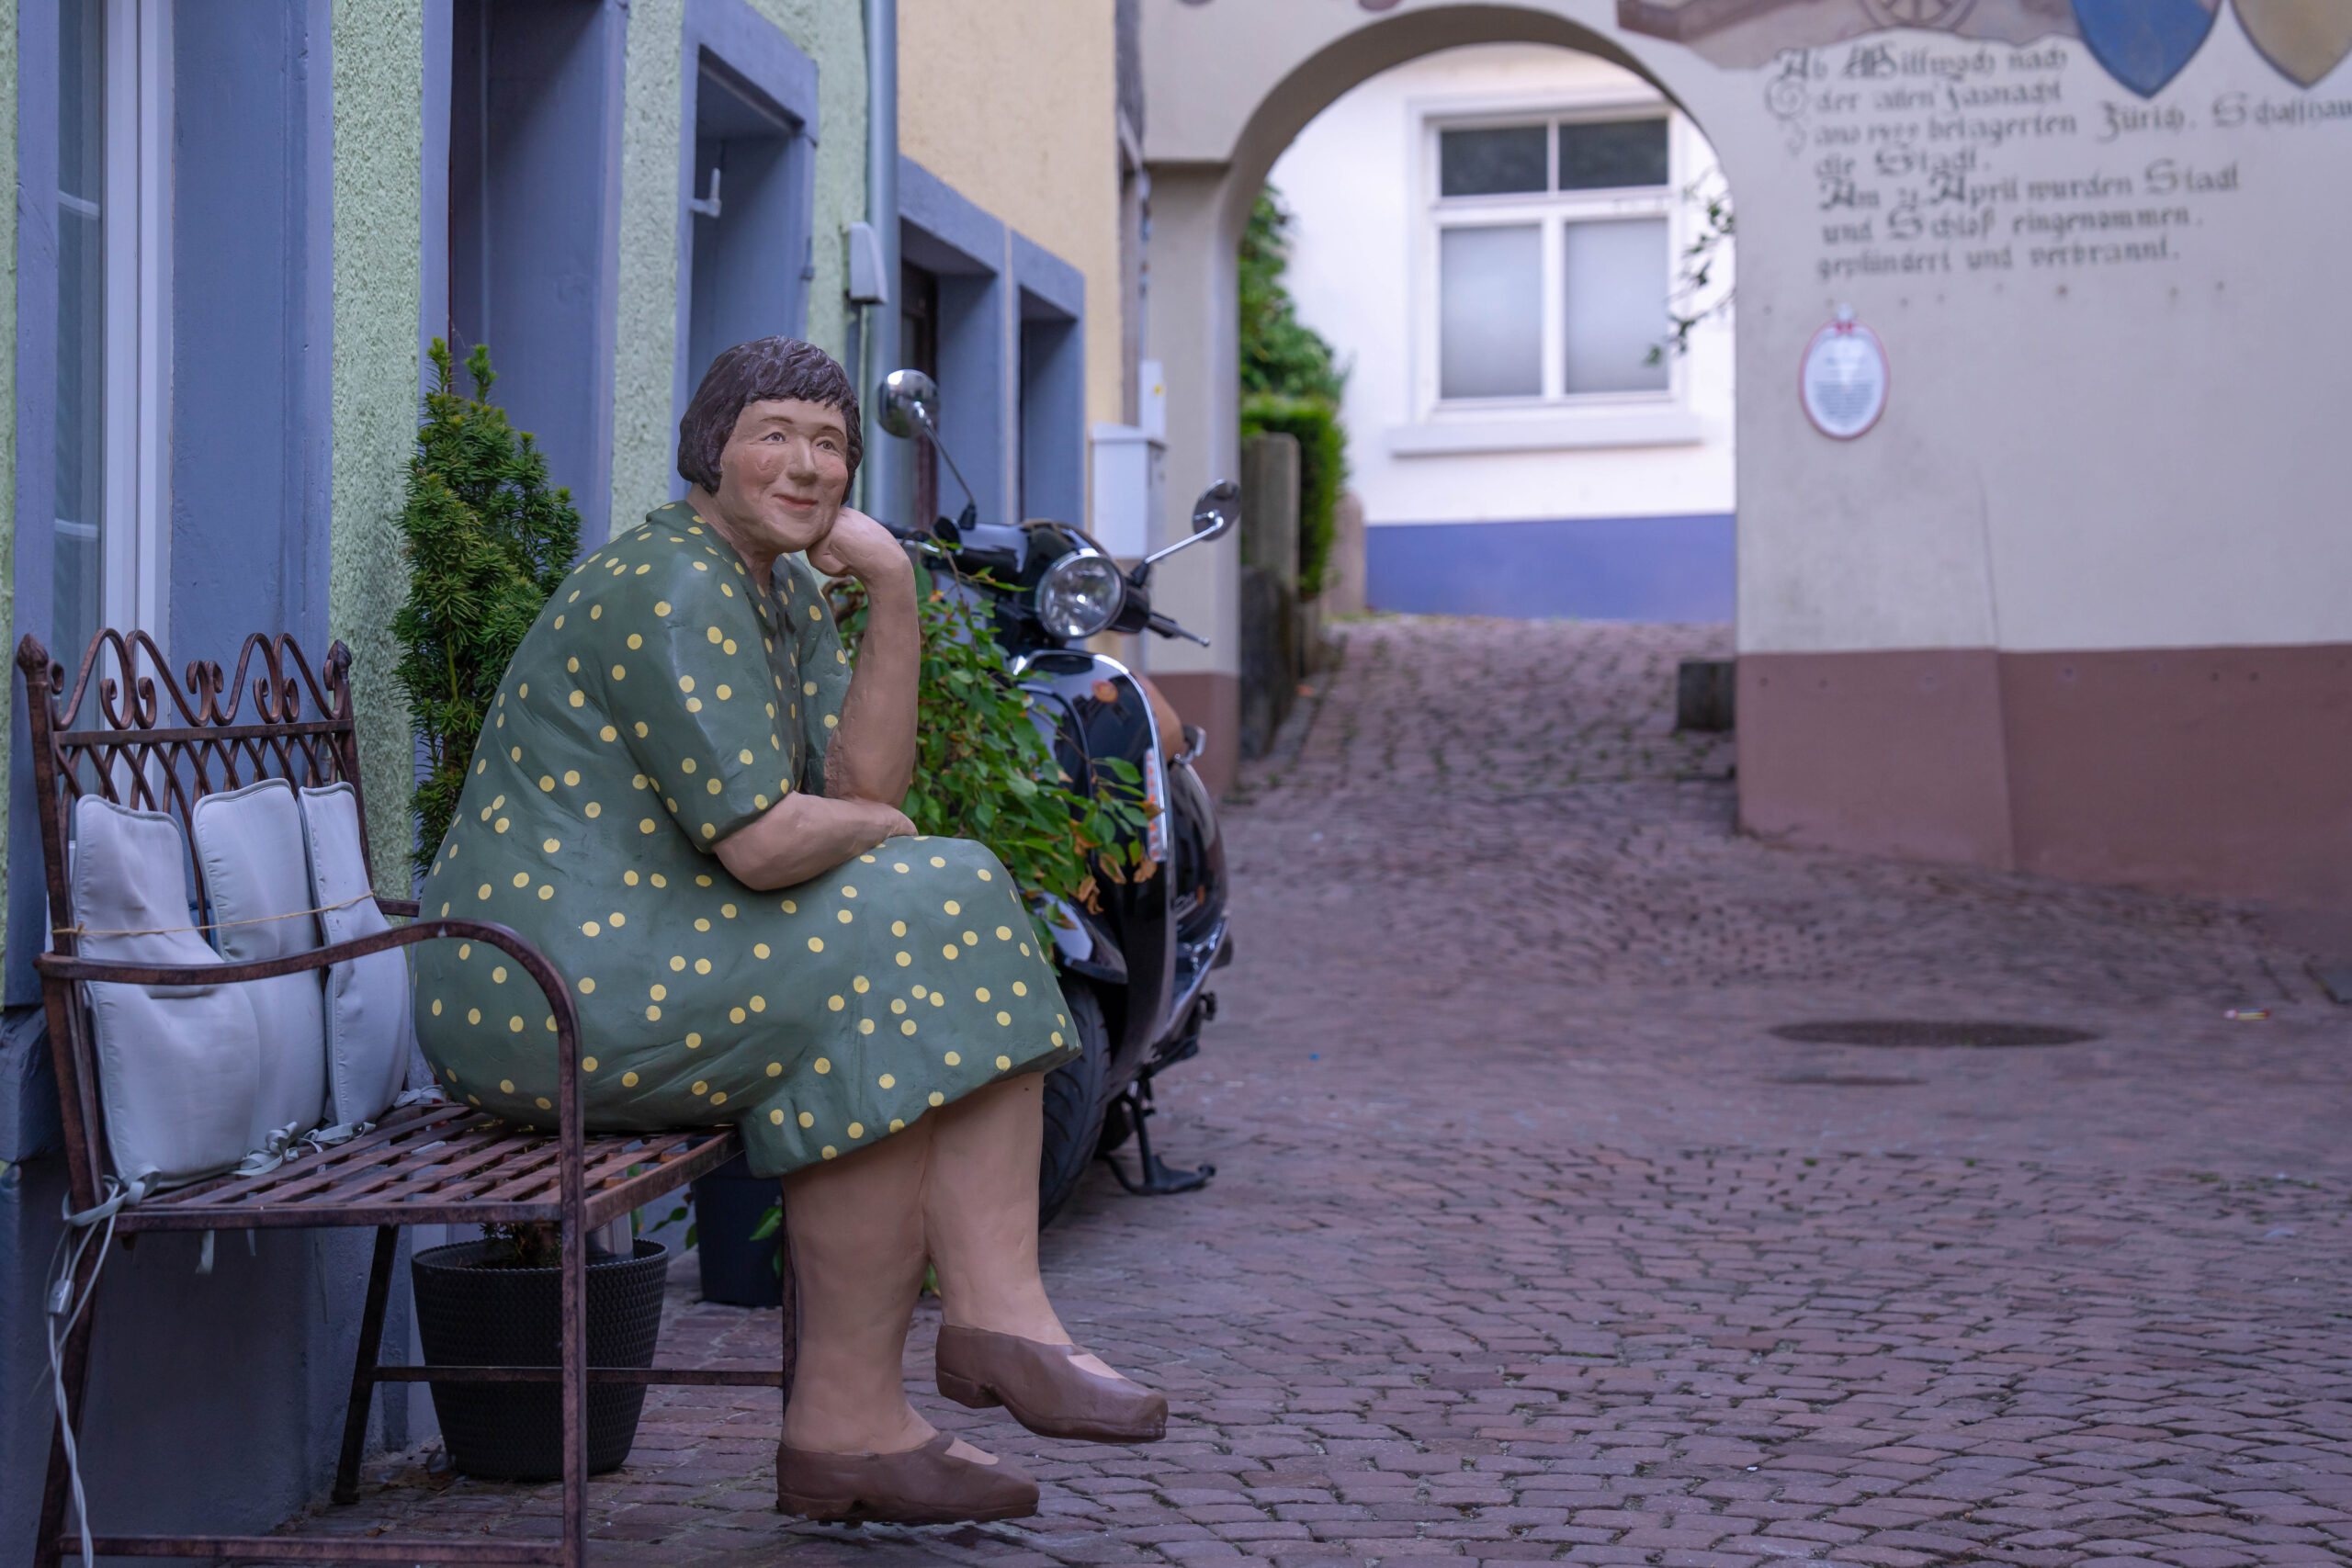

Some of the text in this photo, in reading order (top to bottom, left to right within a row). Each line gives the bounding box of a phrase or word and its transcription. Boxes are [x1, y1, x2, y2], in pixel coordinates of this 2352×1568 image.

[1814, 85, 1858, 112] der
[1815, 152, 1856, 178] die
[1817, 175, 1881, 212] Am
[2026, 167, 2133, 201] wurden
[2143, 157, 2240, 196] Stadt
[1821, 216, 1873, 245] und
[1965, 239, 2014, 271] und
